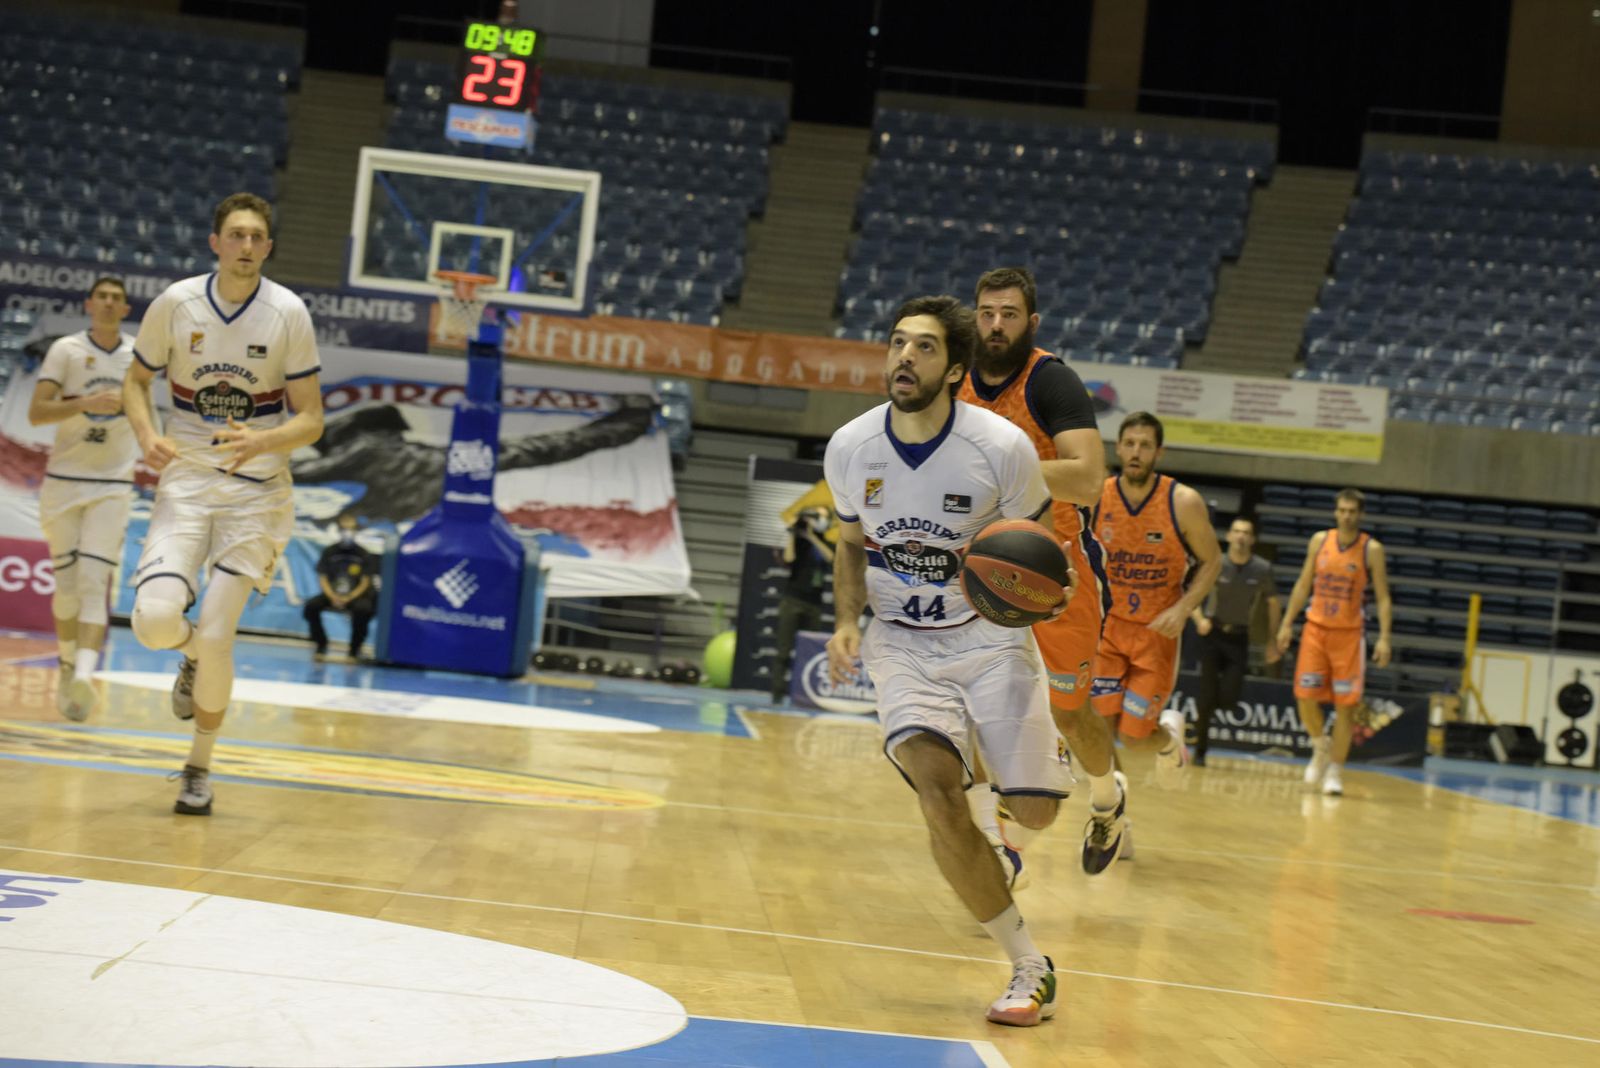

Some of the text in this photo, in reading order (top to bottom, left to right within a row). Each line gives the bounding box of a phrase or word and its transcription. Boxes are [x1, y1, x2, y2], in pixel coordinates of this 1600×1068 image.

[462, 55, 527, 106] 23
[665, 346, 886, 387] ABOGADO
[84, 427, 107, 443] 32
[902, 594, 947, 622] 44
[1128, 592, 1141, 615] 9
[1235, 729, 1294, 747] RIBEIRA
